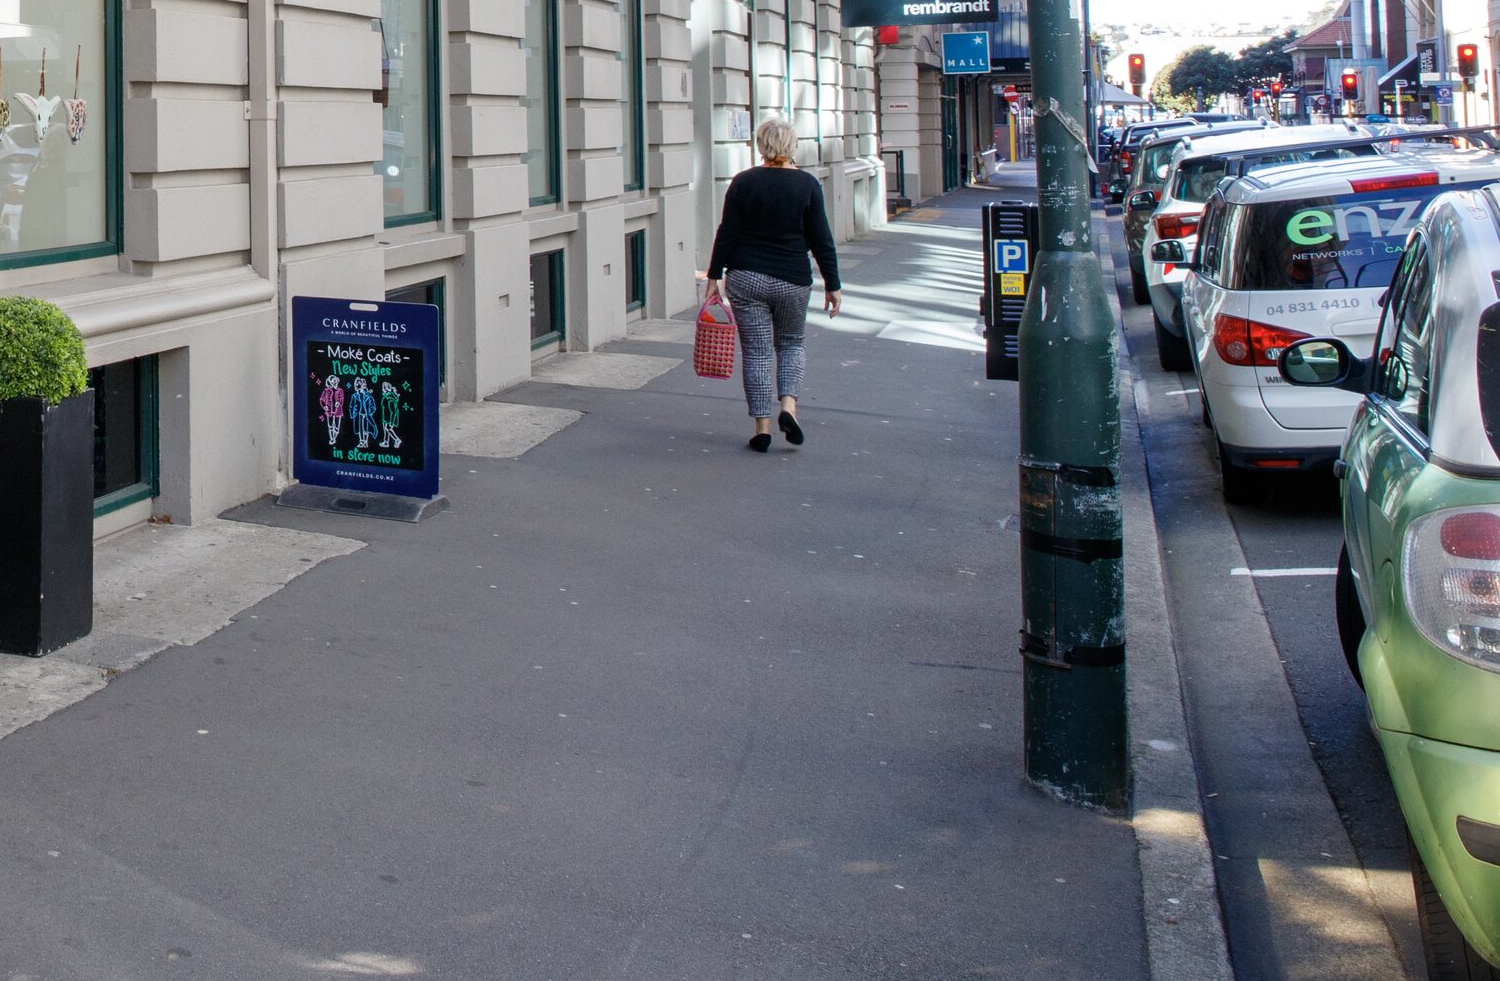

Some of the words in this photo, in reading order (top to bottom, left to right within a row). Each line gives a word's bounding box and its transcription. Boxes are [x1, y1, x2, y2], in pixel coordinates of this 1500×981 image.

[947, 58, 986, 67] MALL
[1292, 248, 1364, 260] NETWORKS
[1384, 246, 1404, 254] CA
[1266, 305, 1284, 316] 04
[1288, 301, 1317, 314] 831
[1320, 298, 1360, 310] 4410
[322, 317, 407, 333] CRANFIELDS
[367, 348, 402, 363] Coats
[332, 360, 358, 376] New
[360, 361, 392, 384] Styles
[333, 446, 343, 459] in
[347, 447, 375, 462] store
[378, 454, 401, 465] now
[336, 470, 394, 481] CRANFIELDS.CO.NZ
